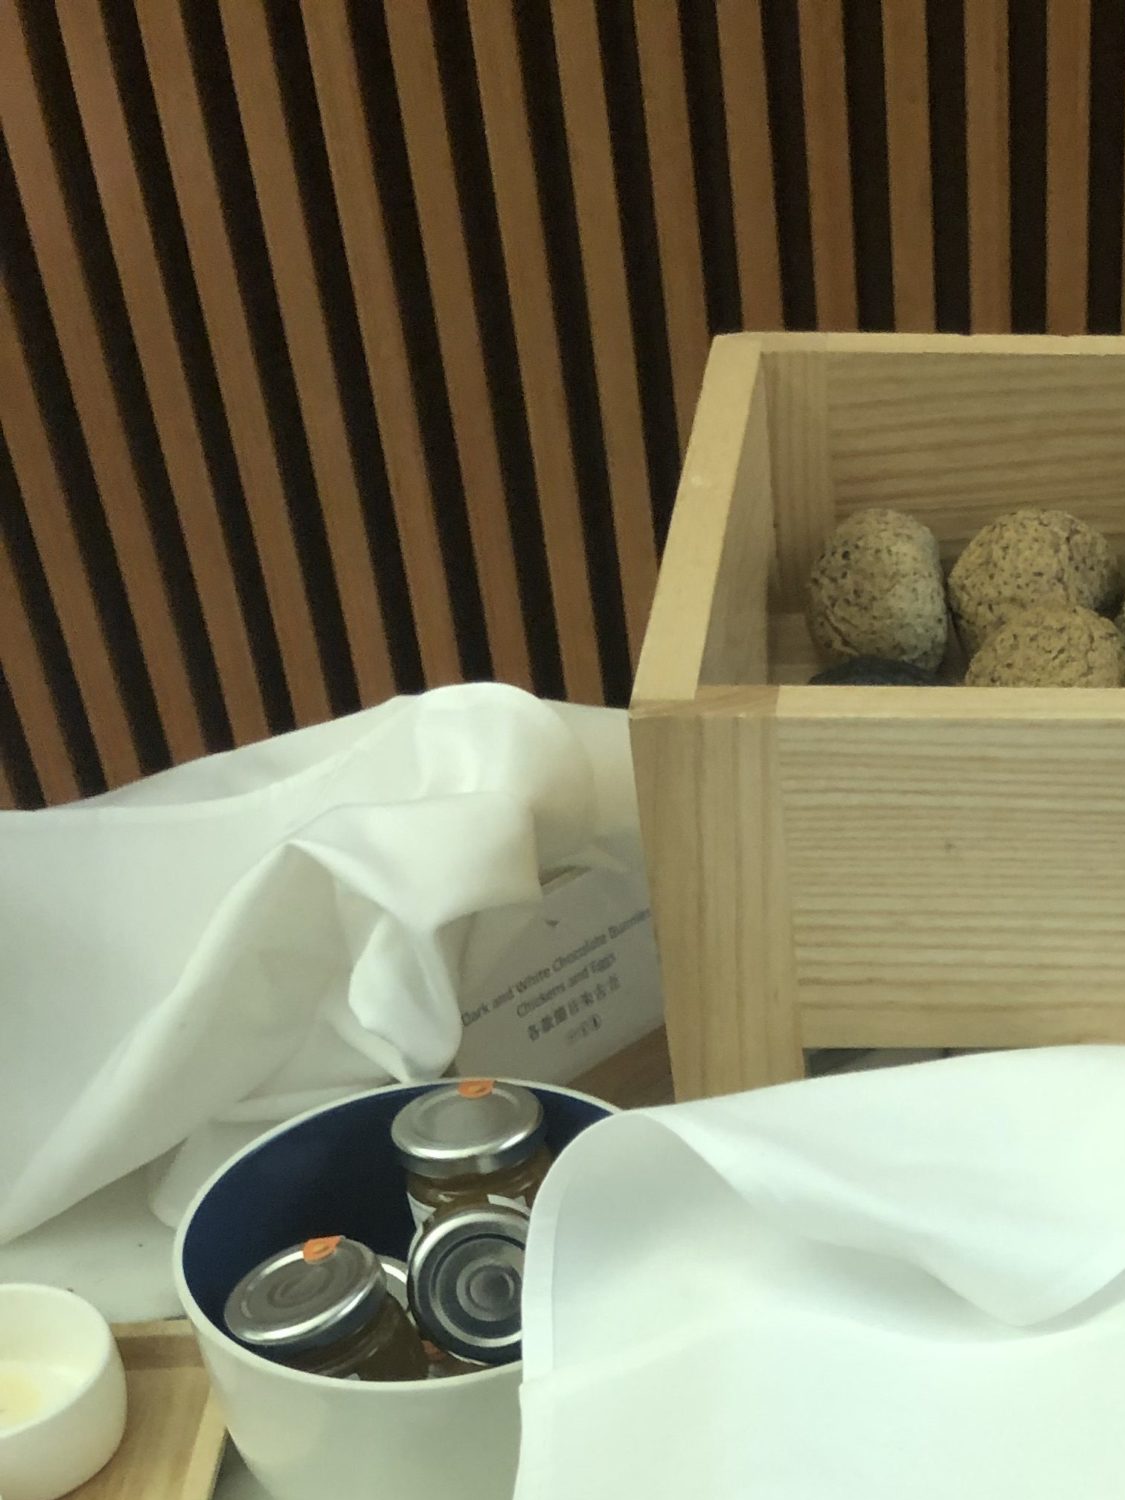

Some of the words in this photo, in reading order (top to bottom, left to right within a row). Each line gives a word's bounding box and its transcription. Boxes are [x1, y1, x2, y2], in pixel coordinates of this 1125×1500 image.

[461, 1002, 490, 1027] Dark
[492, 985, 515, 1010] and
[515, 968, 551, 994] White
[551, 933, 608, 973] Chocolate
[517, 982, 566, 1019] Chickens
[567, 966, 589, 989] and
[590, 952, 617, 976] Eggs
